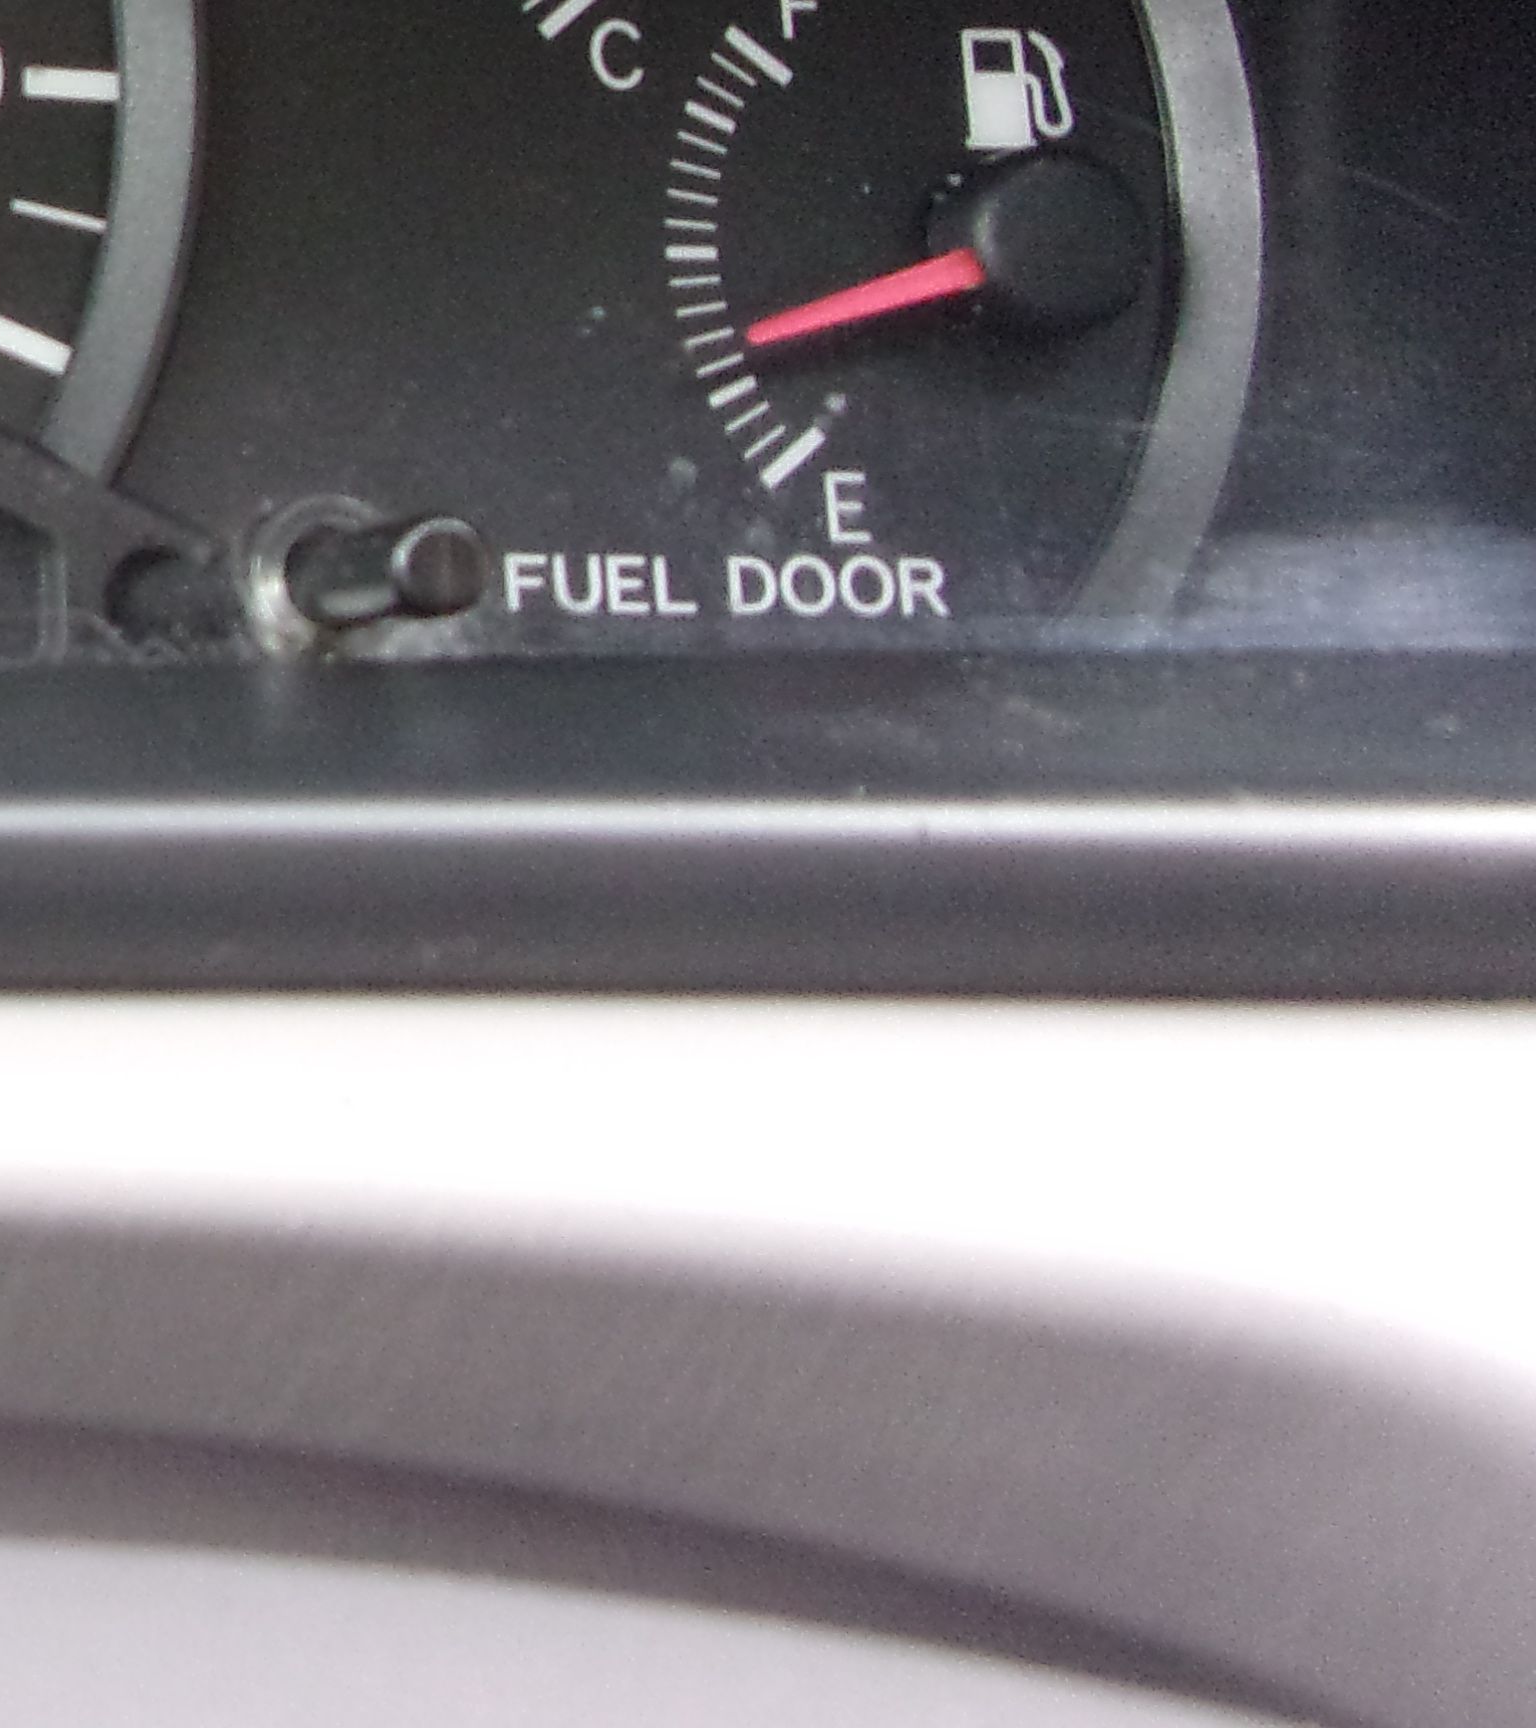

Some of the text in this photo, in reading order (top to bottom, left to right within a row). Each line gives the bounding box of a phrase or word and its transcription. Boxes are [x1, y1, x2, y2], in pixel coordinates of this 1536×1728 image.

[589, 18, 644, 91] C
[824, 471, 866, 544] E
[504, 552, 948, 617] FUEL DOOR
